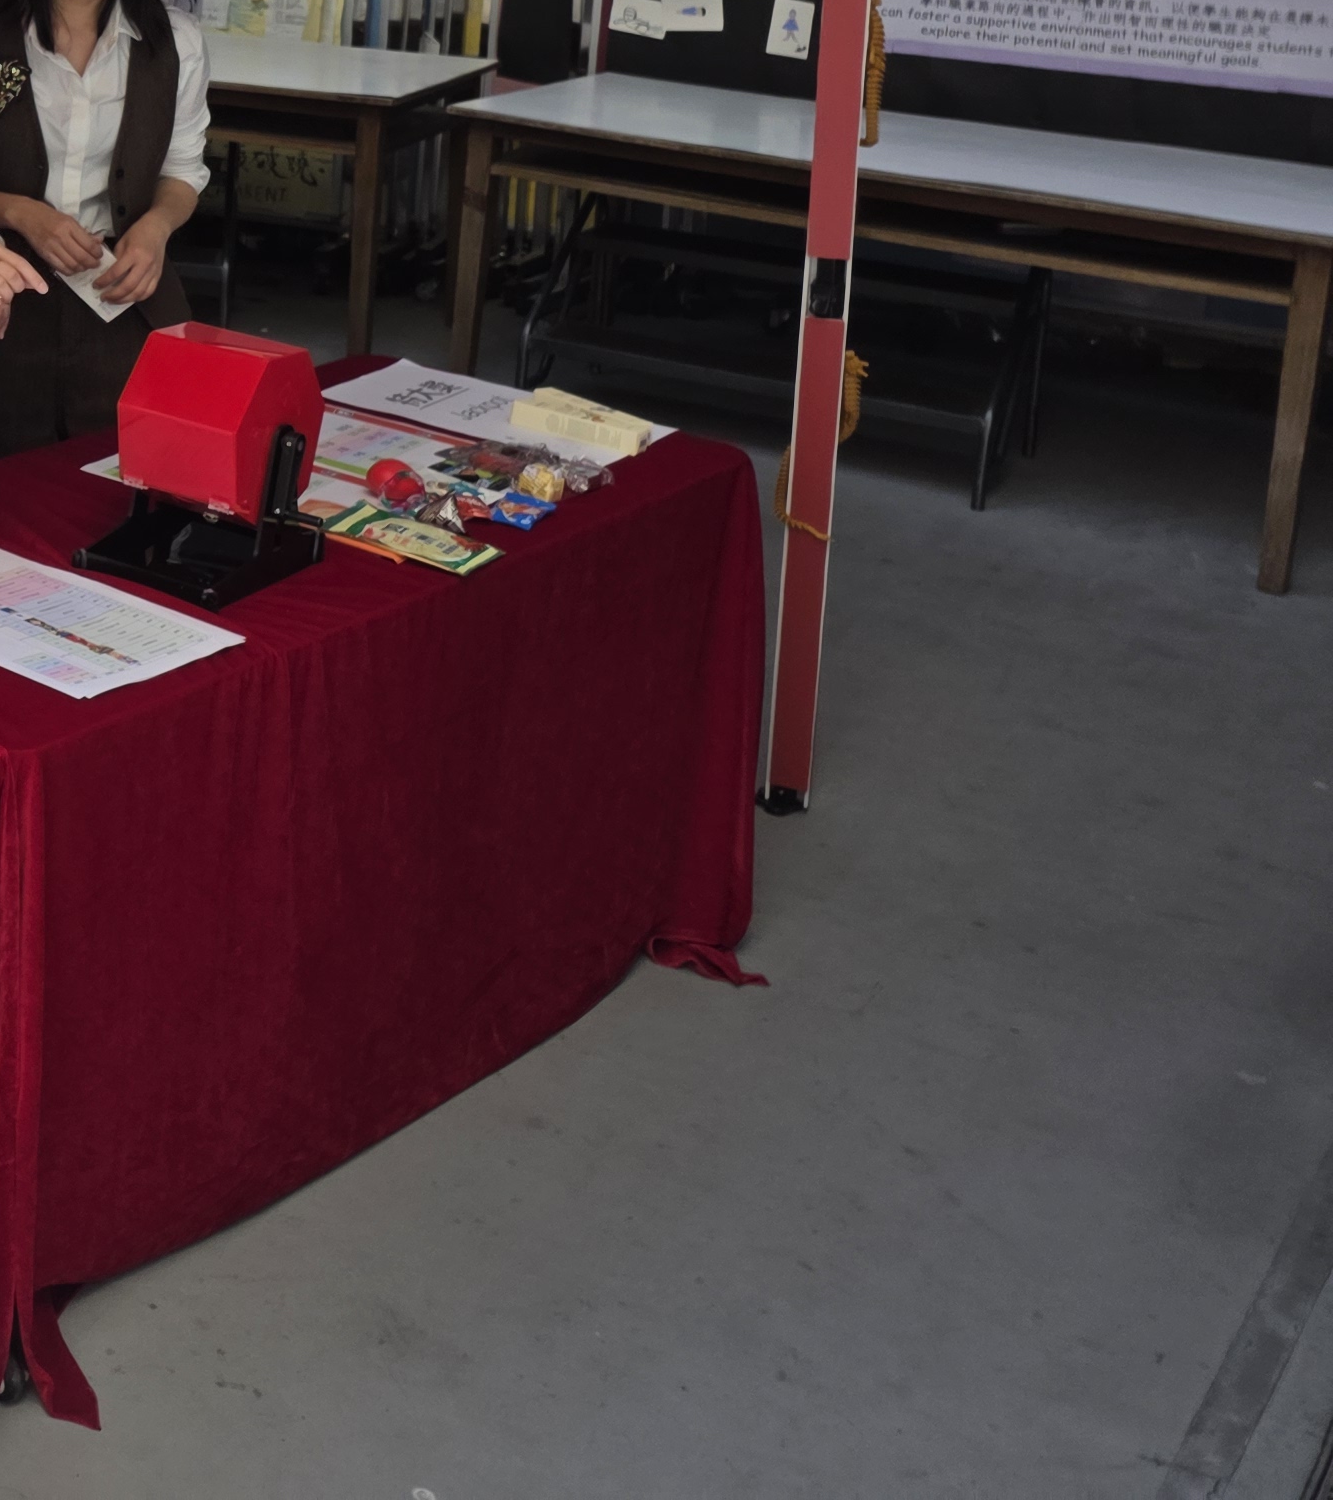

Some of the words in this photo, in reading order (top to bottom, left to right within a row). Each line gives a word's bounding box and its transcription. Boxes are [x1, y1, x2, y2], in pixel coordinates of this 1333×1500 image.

[881, 8, 903, 18] can
[907, 7, 950, 23] foster
[953, 15, 961, 24] a
[966, 15, 1036, 32] supportive
[1041, 22, 1127, 40] environment
[1133, 30, 1164, 43] that
[1169, 34, 1252, 52] encourages
[1257, 40, 1323, 58] students
[920, 26, 971, 40] explore
[976, 29, 1009, 43] their
[1013, 33, 1076, 50] potential
[1080, 40, 1105, 53] and
[1110, 44, 1132, 55] set
[1138, 47, 1216, 65] meaningful
